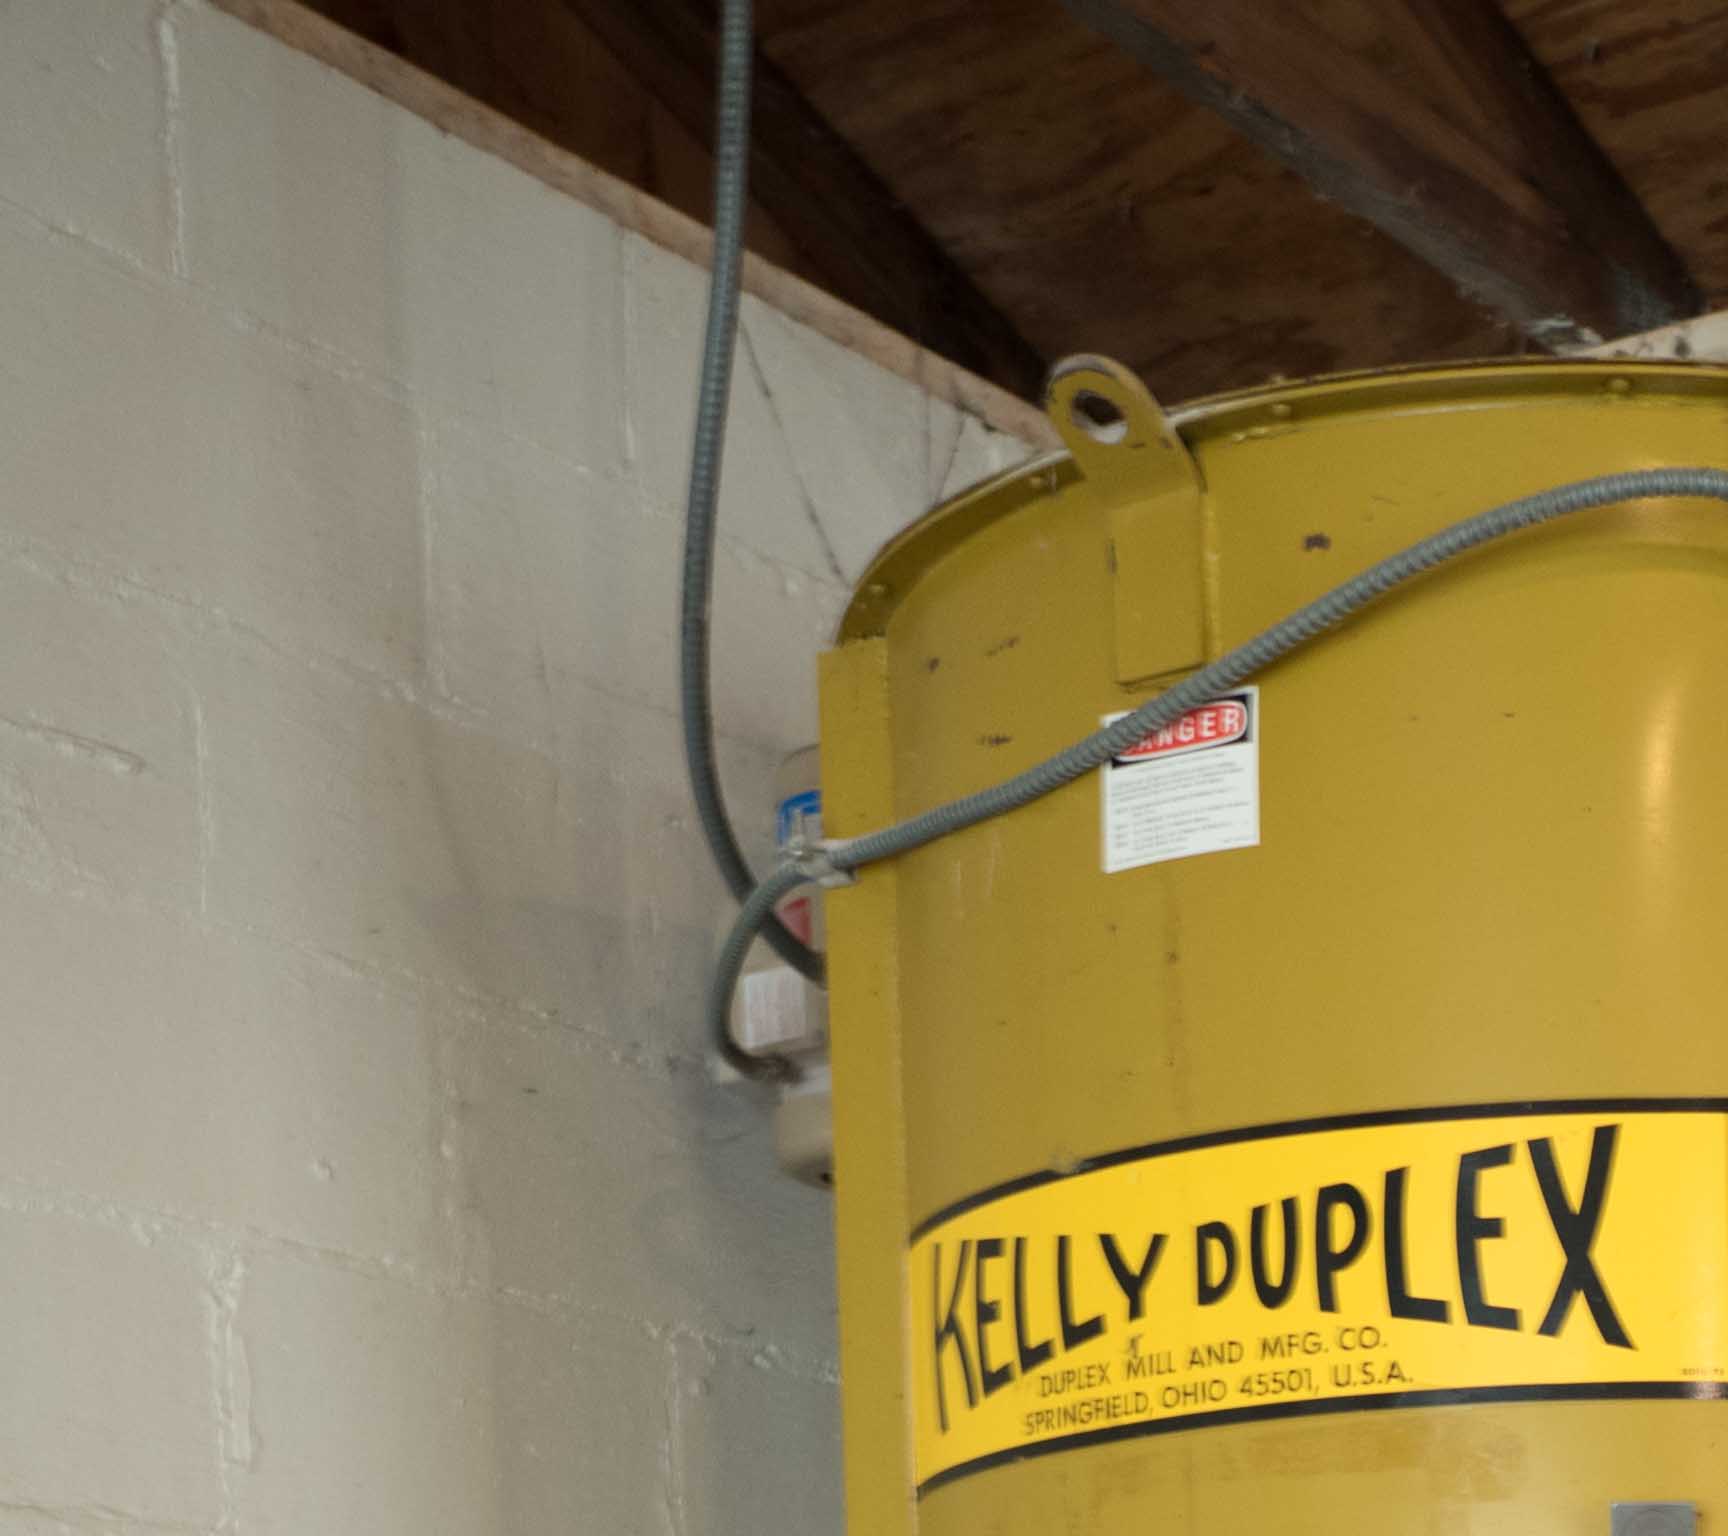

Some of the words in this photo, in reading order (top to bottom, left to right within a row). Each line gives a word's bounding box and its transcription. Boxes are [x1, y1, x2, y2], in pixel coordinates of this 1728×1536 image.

[933, 1233, 1170, 1436] KELLY
[1195, 1123, 1638, 1351] DUPLEX
[1025, 1391, 1153, 1437] SPRINGFIELD,
[1161, 1379, 1228, 1410] OHIO
[1239, 1367, 1320, 1398] 45501,
[1332, 1360, 1414, 1390] U.S.A.
[1040, 1362, 1111, 1398] DUPLEX
[1126, 1351, 1177, 1380] MILL
[1189, 1340, 1245, 1371] AND
[1260, 1331, 1329, 1362] MFG.
[1337, 1325, 1388, 1350] CO.
